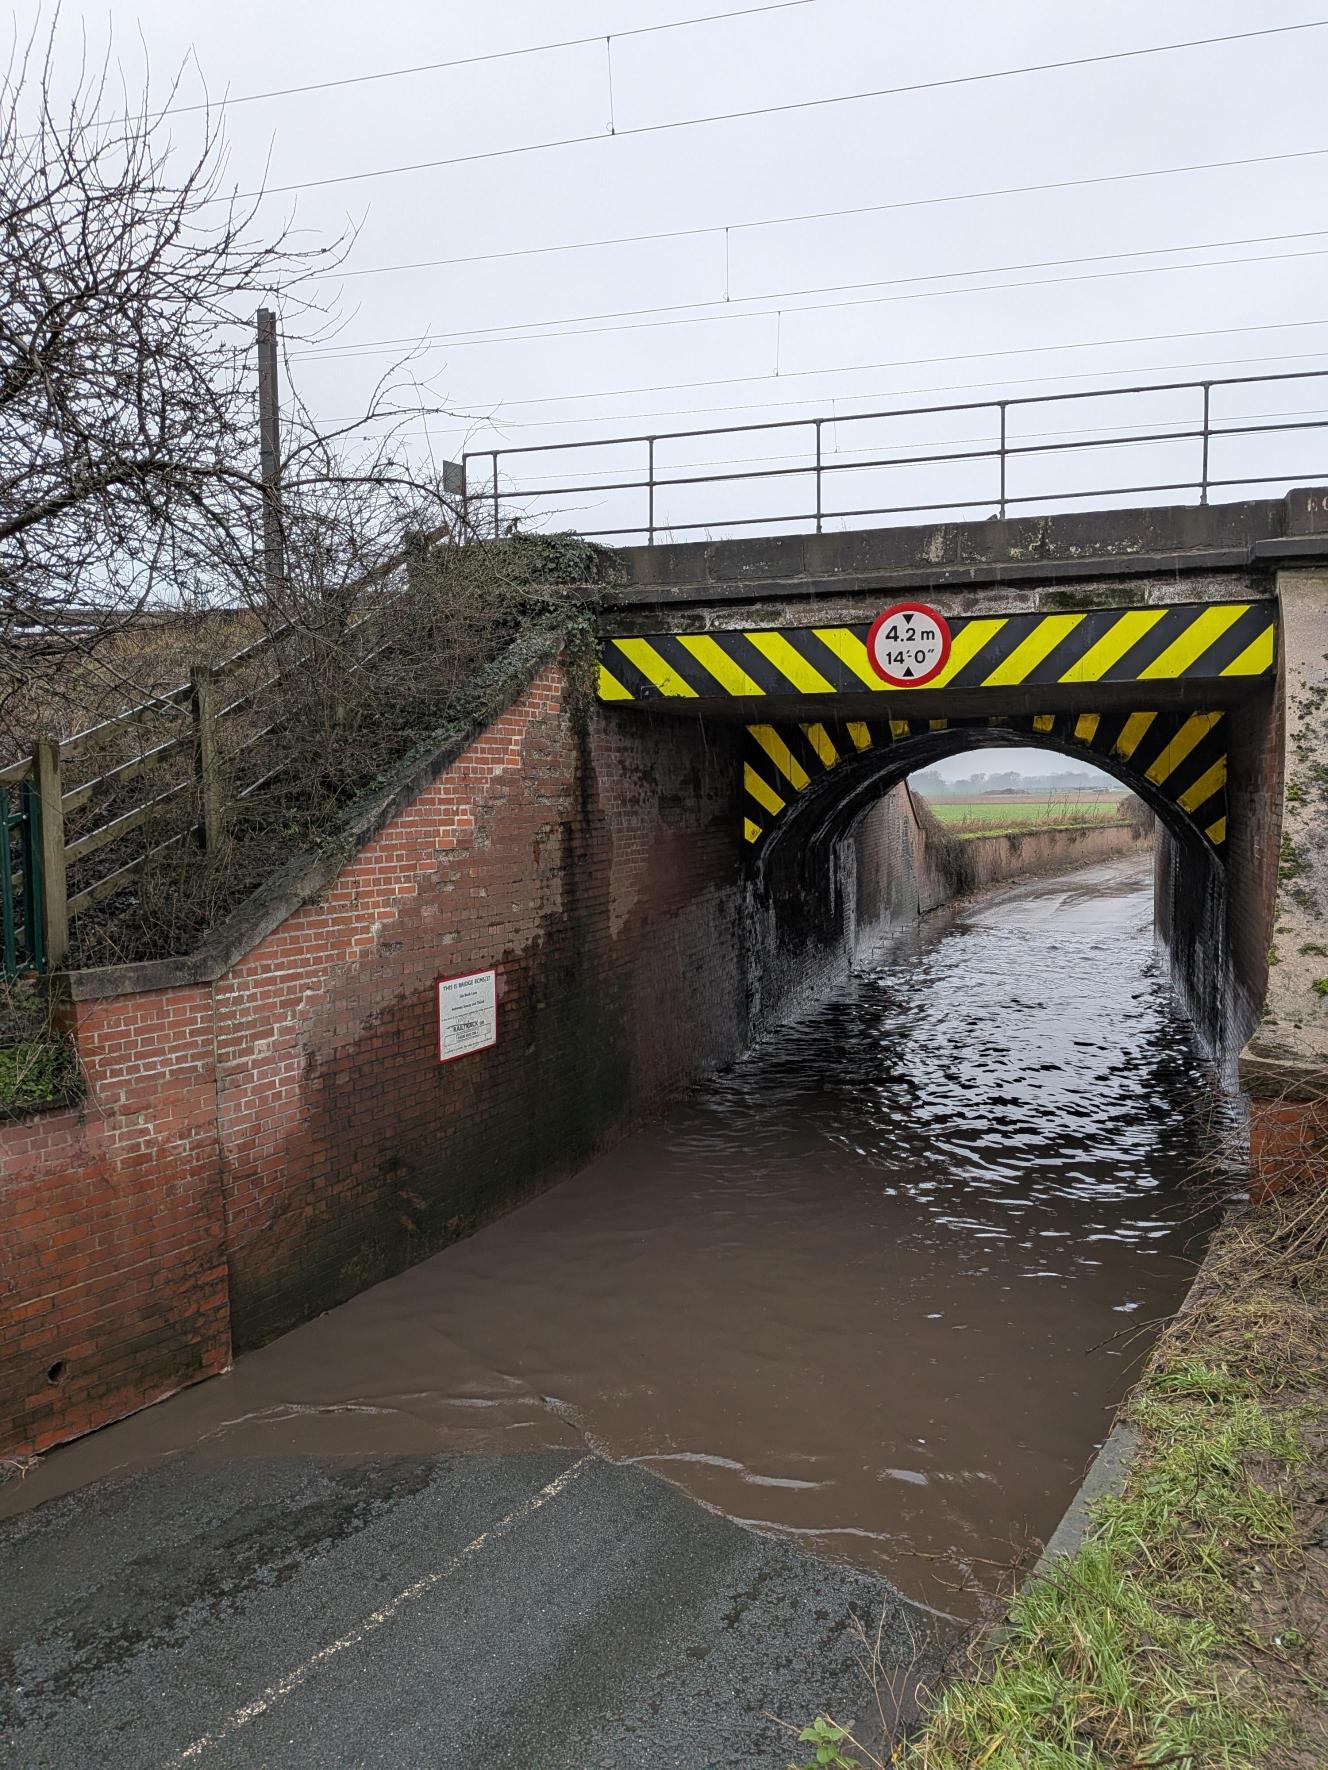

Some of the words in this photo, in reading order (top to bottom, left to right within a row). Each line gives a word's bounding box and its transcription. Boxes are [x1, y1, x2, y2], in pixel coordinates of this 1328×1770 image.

[885, 625, 916, 642] 4.2
[920, 629, 935, 641] m
[459, 980, 474, 988] BRIDGE
